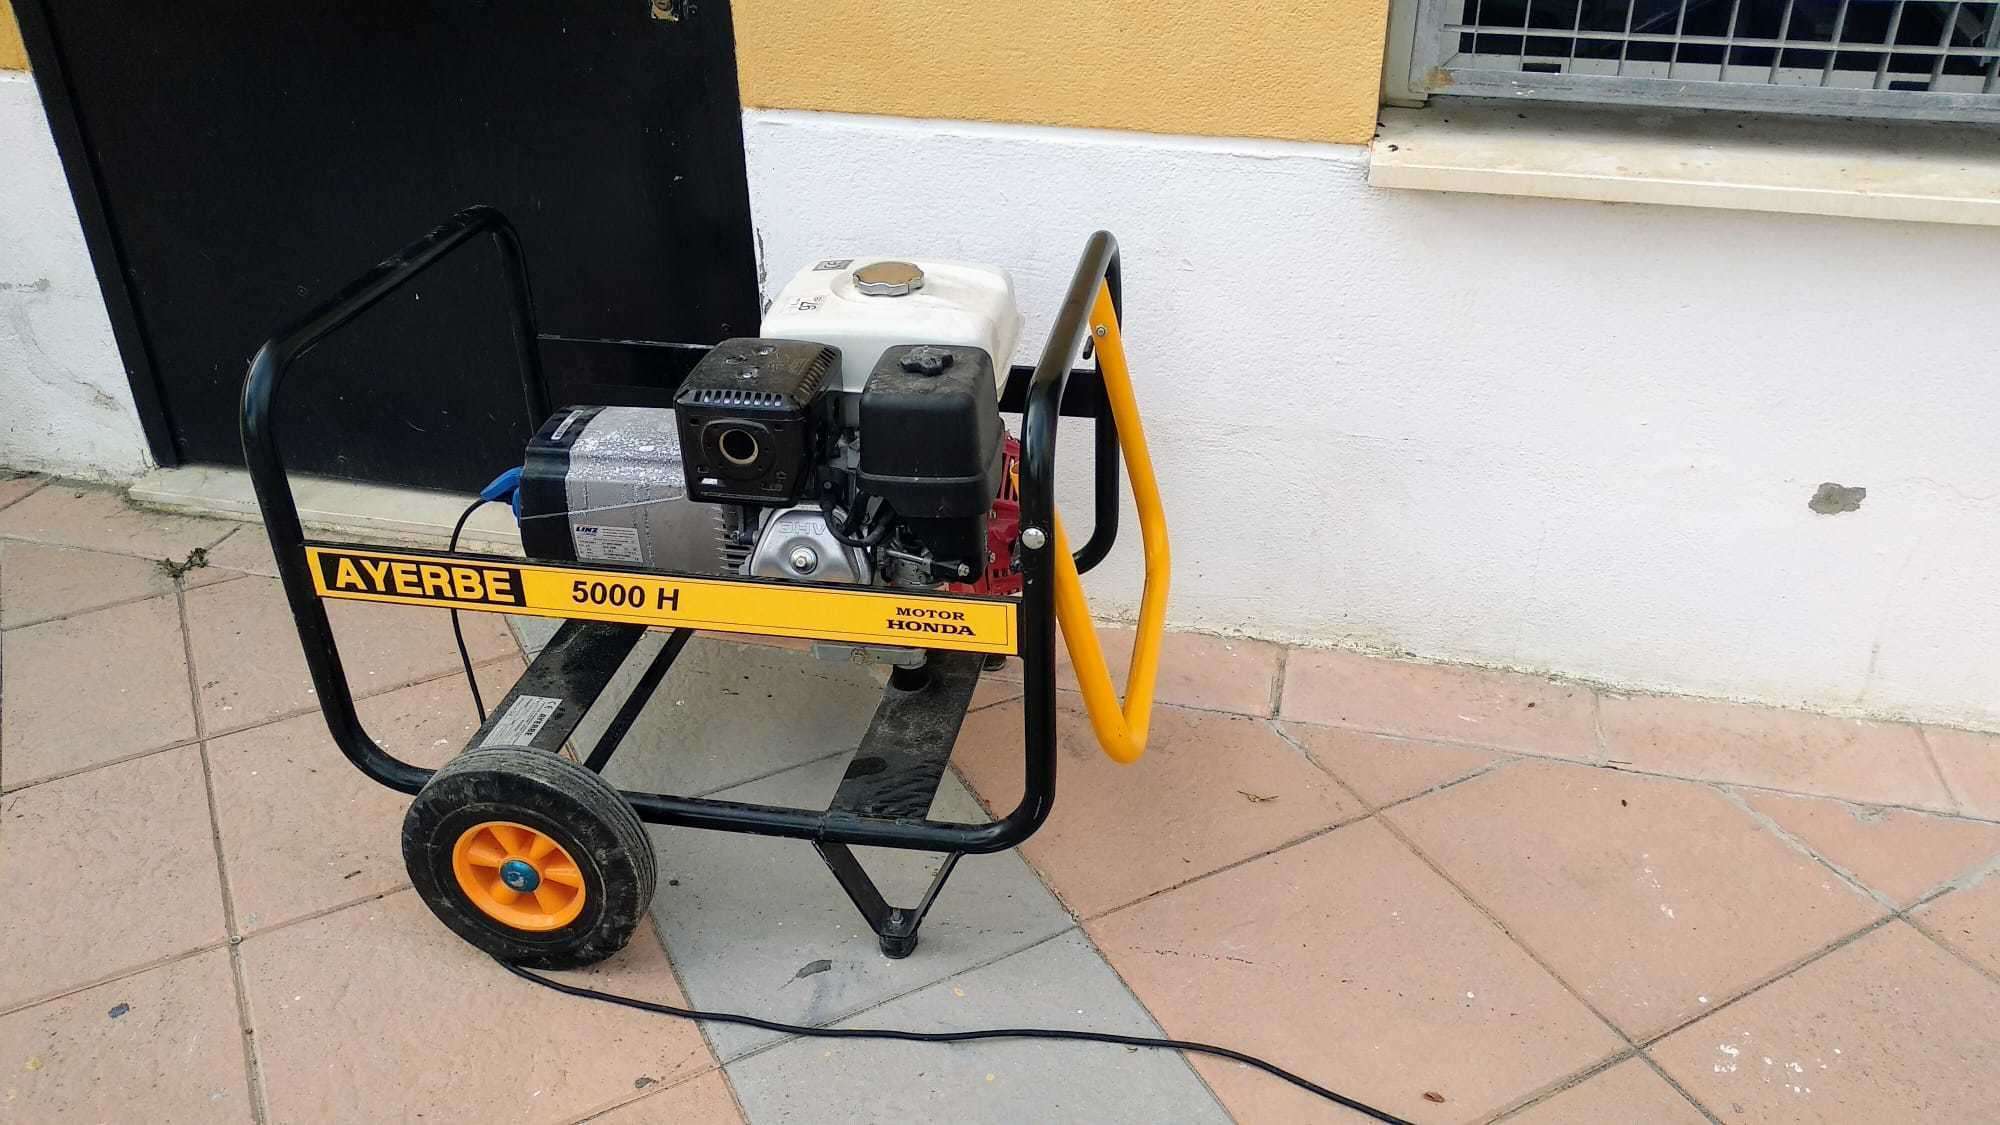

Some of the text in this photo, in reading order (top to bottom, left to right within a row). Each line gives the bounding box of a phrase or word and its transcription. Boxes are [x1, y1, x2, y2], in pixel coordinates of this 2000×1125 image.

[576, 526, 599, 534] LINZ
[335, 557, 517, 603] AYERBE
[571, 580, 680, 612] 5000 H
[895, 606, 966, 621] MOTOR
[886, 618, 977, 637] HONDA
[524, 713, 548, 737] AYERBE
